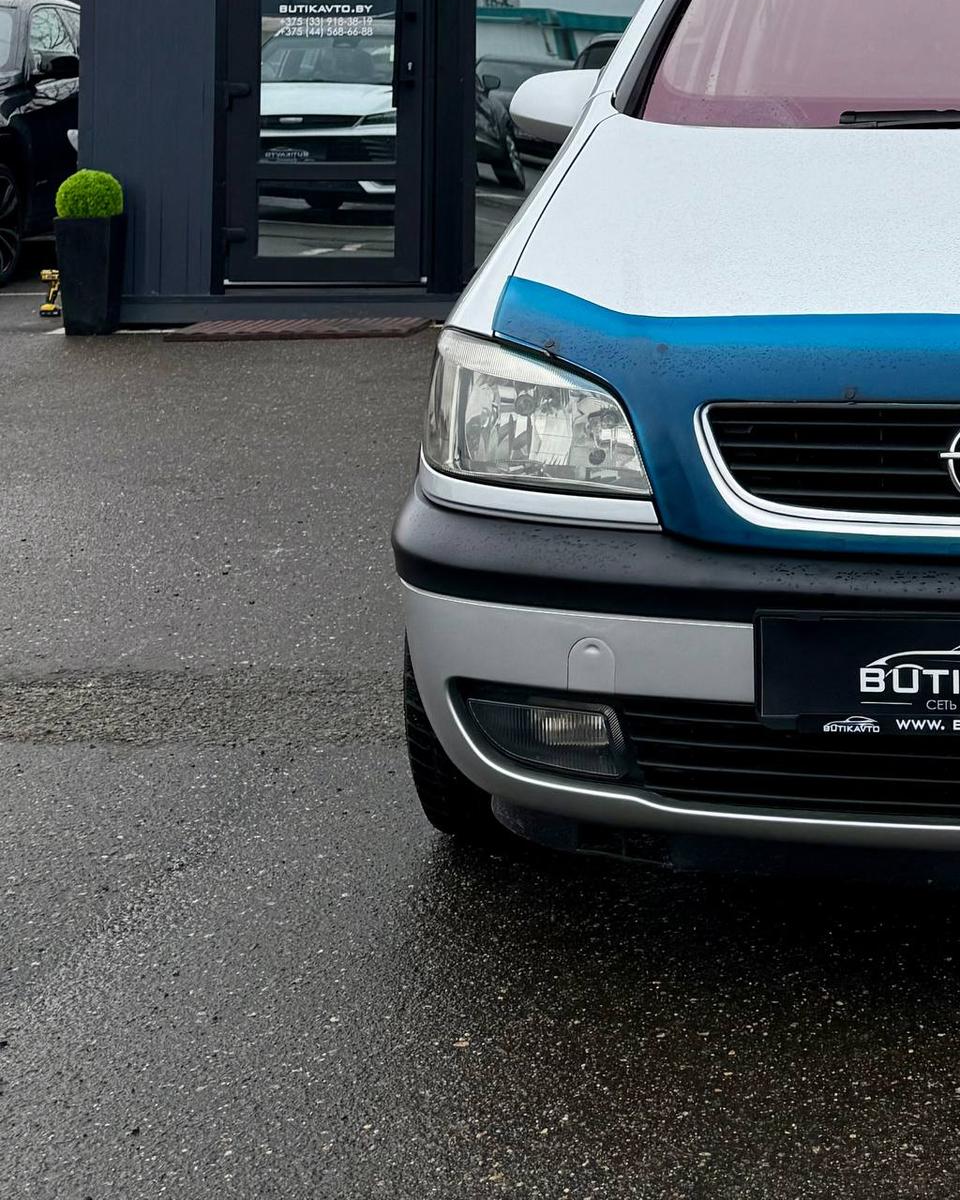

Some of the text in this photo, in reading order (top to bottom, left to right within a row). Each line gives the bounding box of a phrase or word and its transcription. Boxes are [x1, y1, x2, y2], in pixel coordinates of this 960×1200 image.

[279, 4, 373, 13] BUTIKAVTO.BY
[279, 17, 303, 26] +375
[305, 17, 324, 28] (33)
[280, 27, 374, 38] +375 (44) 568-66-88
[926, 699, 957, 711] СЕТЬ
[822, 724, 881, 733] BUTIKAVTO
[895, 719, 946, 731] WWW.
